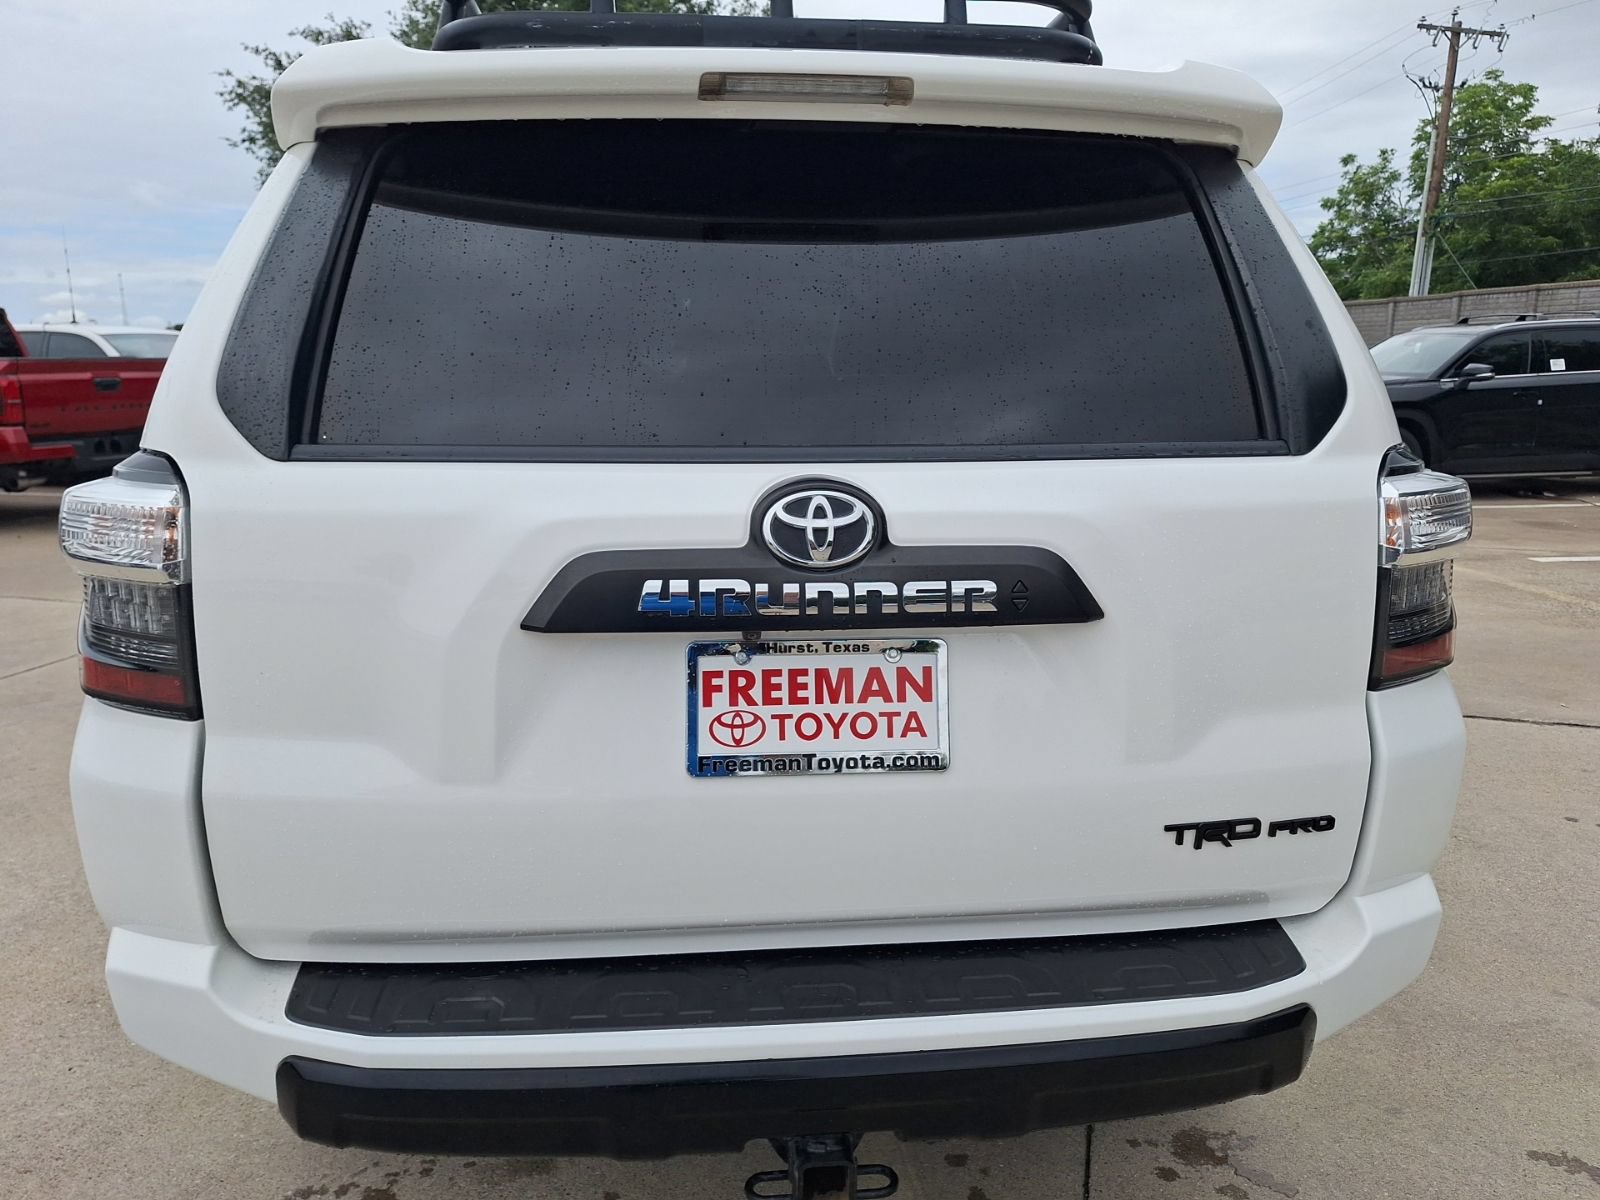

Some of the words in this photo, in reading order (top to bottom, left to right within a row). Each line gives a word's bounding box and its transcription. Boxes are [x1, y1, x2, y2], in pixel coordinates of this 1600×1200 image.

[766, 641, 819, 655] Hurst,
[823, 641, 870, 654] Texas
[702, 665, 934, 708] FREEMAN
[771, 711, 928, 742] TOYOTA
[699, 753, 940, 774] FreemanToyota.com
[1164, 817, 1262, 850] TRD
[1268, 814, 1336, 838] PRO
